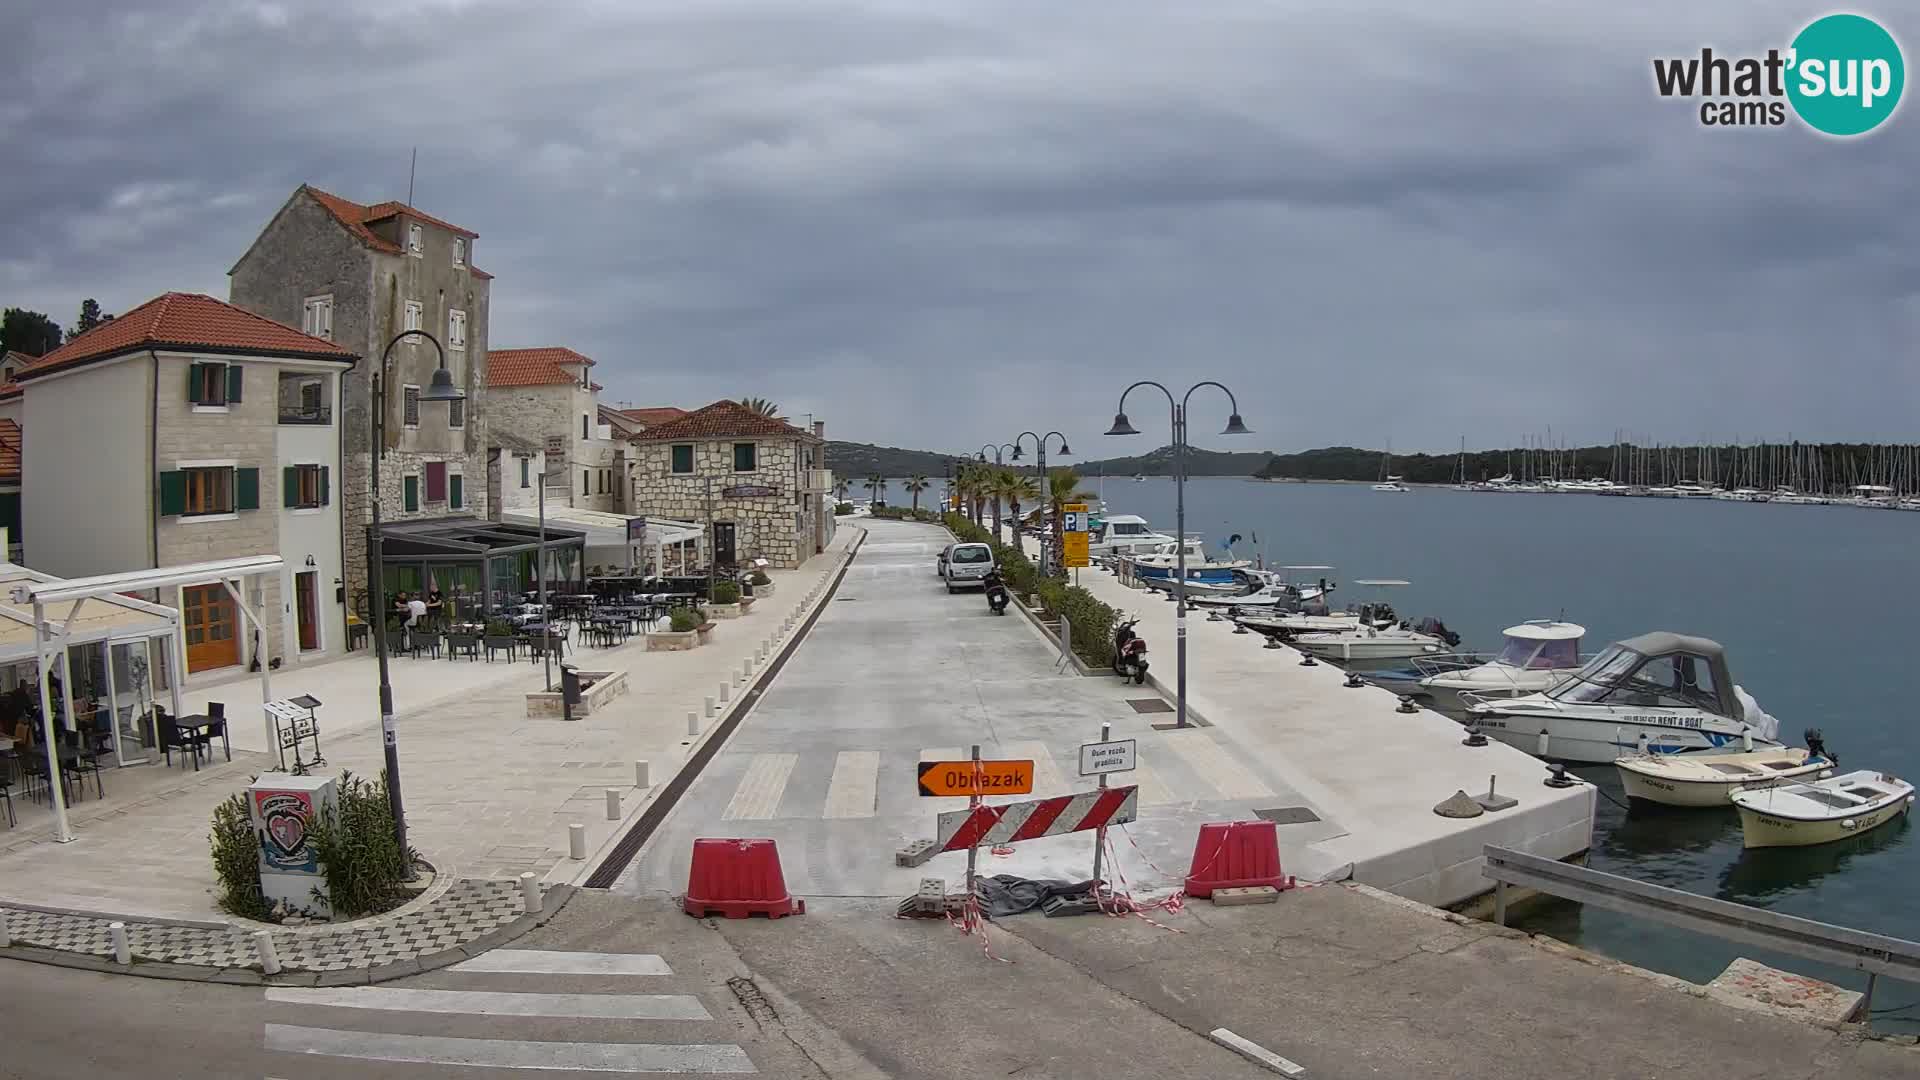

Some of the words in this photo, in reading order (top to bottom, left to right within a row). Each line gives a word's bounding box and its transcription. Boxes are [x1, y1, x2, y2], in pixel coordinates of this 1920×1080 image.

[1065, 514, 1076, 530] P
[1657, 716, 1679, 726] RENT
[1679, 717, 1683, 726] A
[1684, 717, 1704, 728] BOAT
[945, 770, 1025, 788] Obilazak
